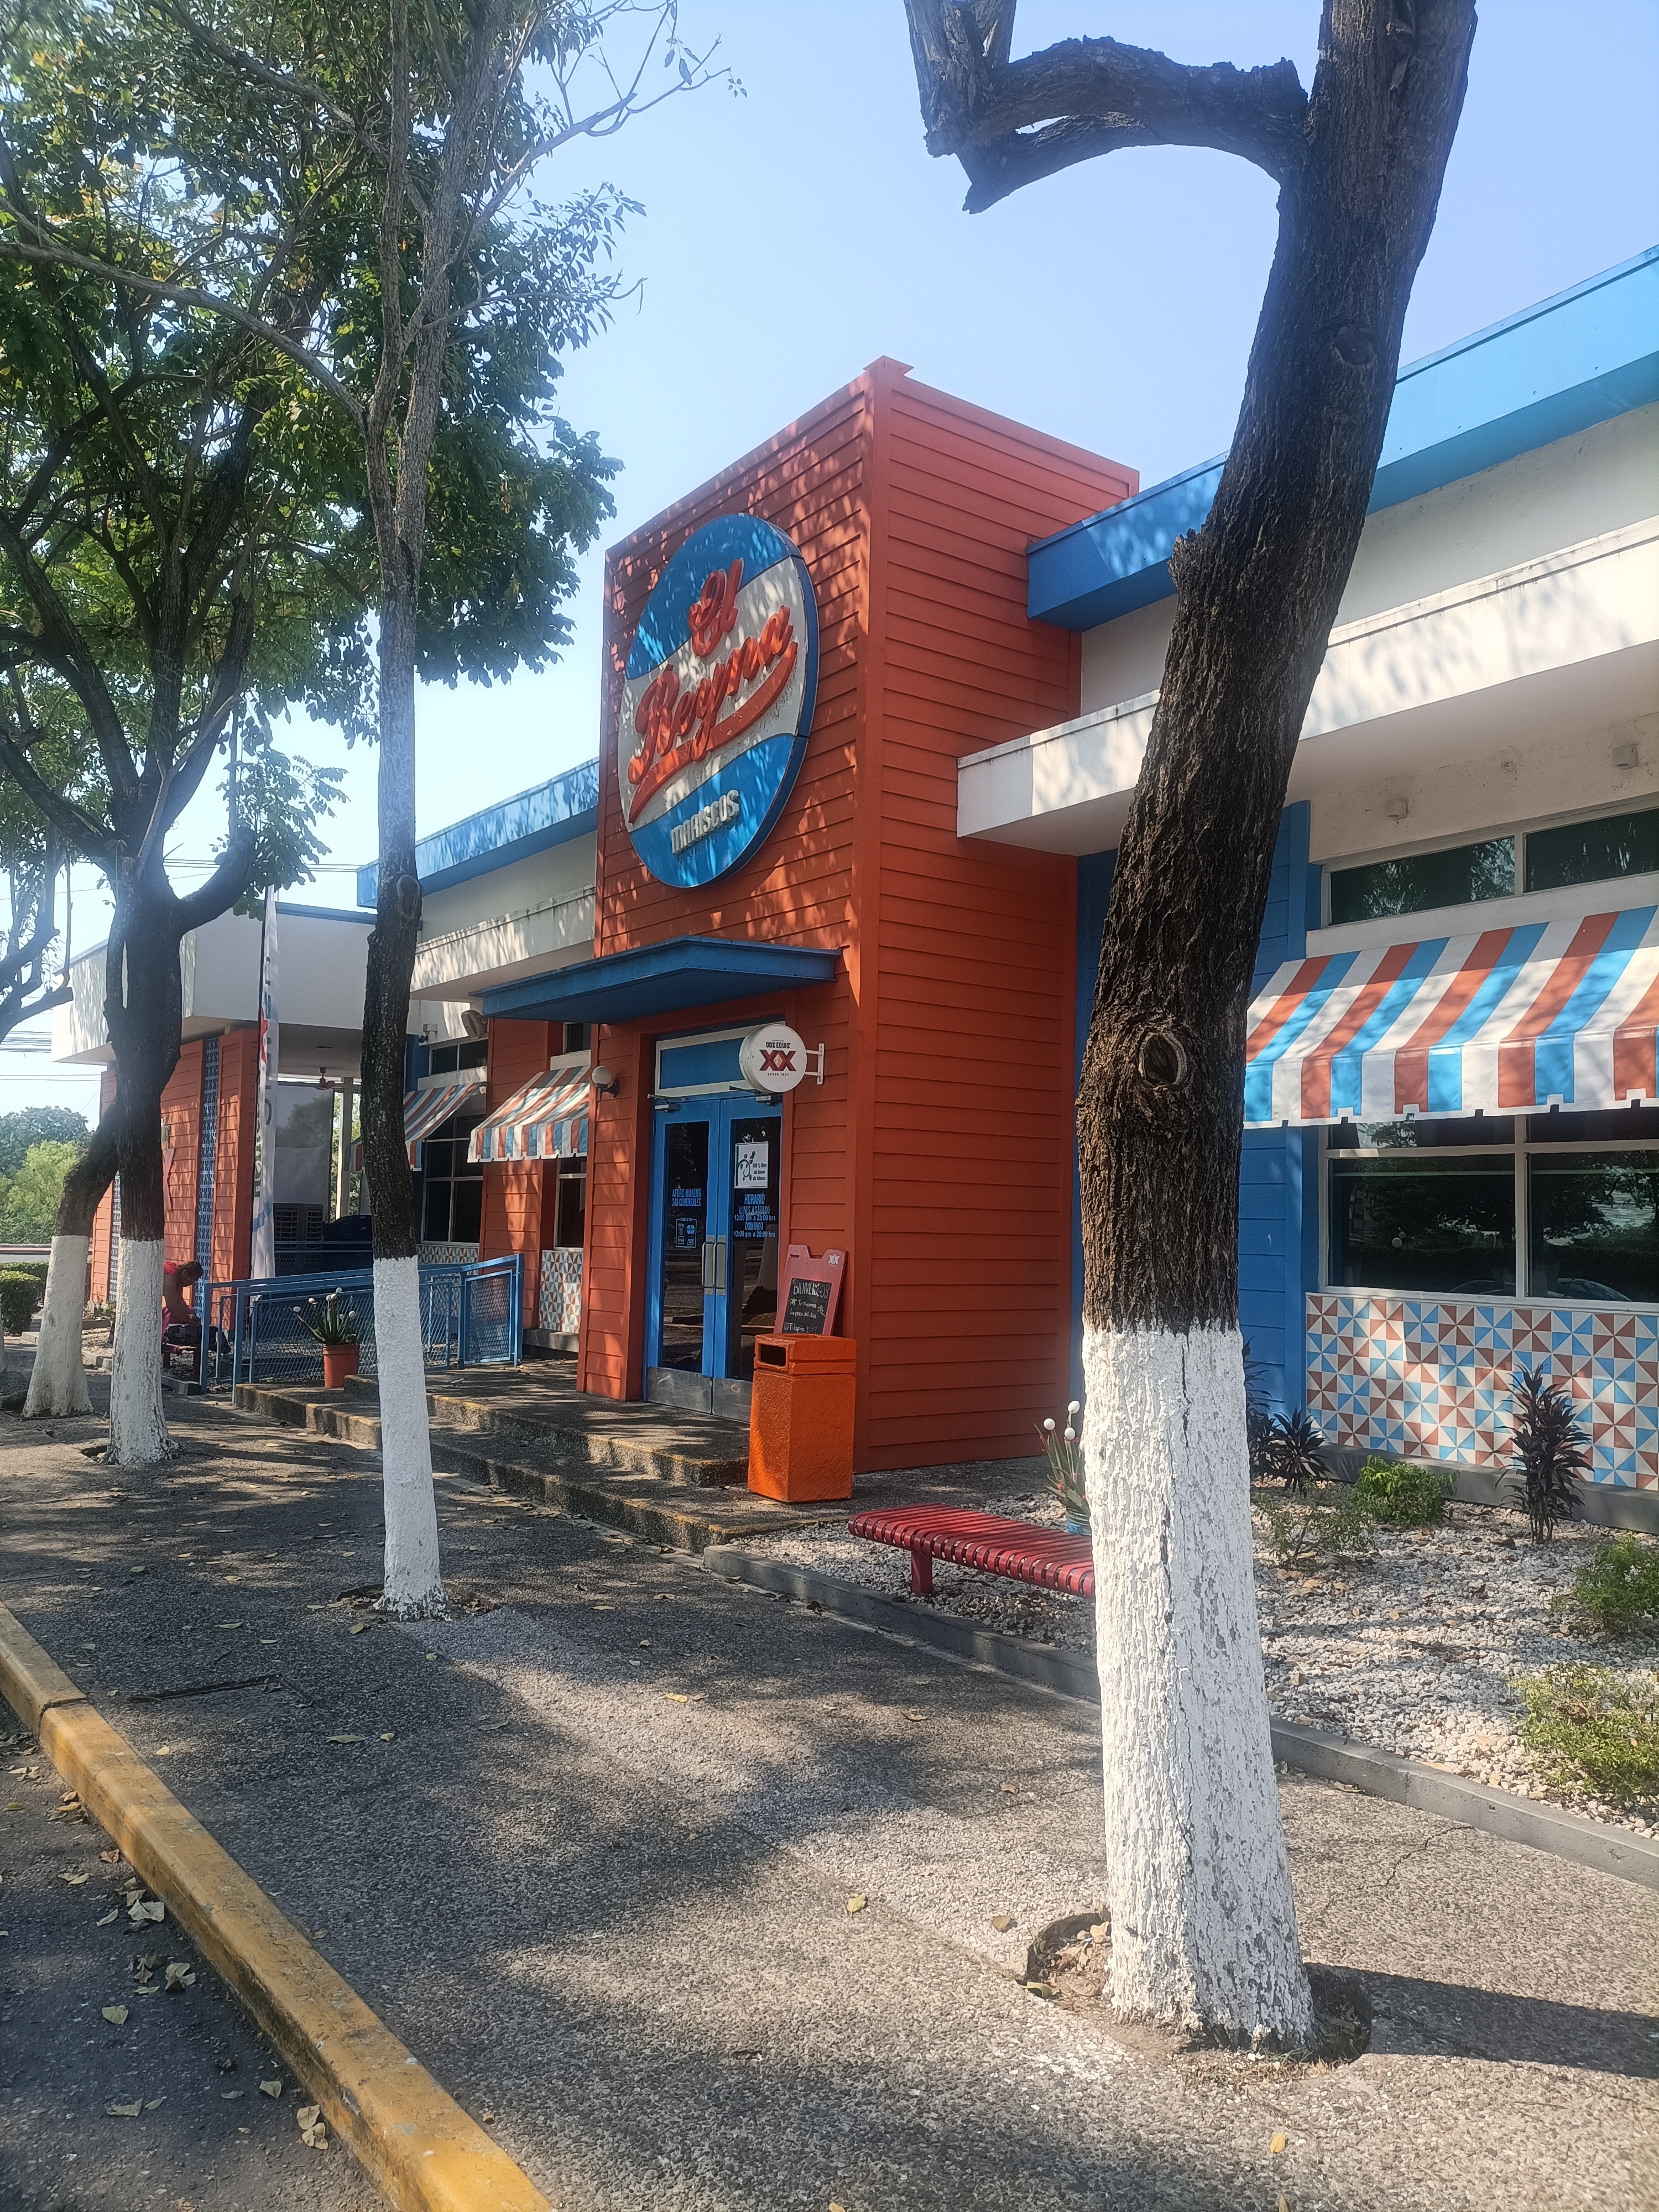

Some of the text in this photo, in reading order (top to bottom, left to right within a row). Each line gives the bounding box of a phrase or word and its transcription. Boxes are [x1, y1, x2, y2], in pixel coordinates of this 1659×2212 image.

[688, 557, 744, 658] El
[628, 604, 794, 785] Reyna
[671, 789, 740, 854] MARISCOS
[759, 1050, 797, 1072] XX
[672, 1188, 685, 1197] AFORO
[679, 1198, 701, 1207] COMENSALES
[744, 1193, 765, 1205] HORARIO
[739, 1206, 751, 1214] LUNES
[745, 1222, 763, 1230] DOMINGO
[789, 1322, 805, 1333] Tilapia
